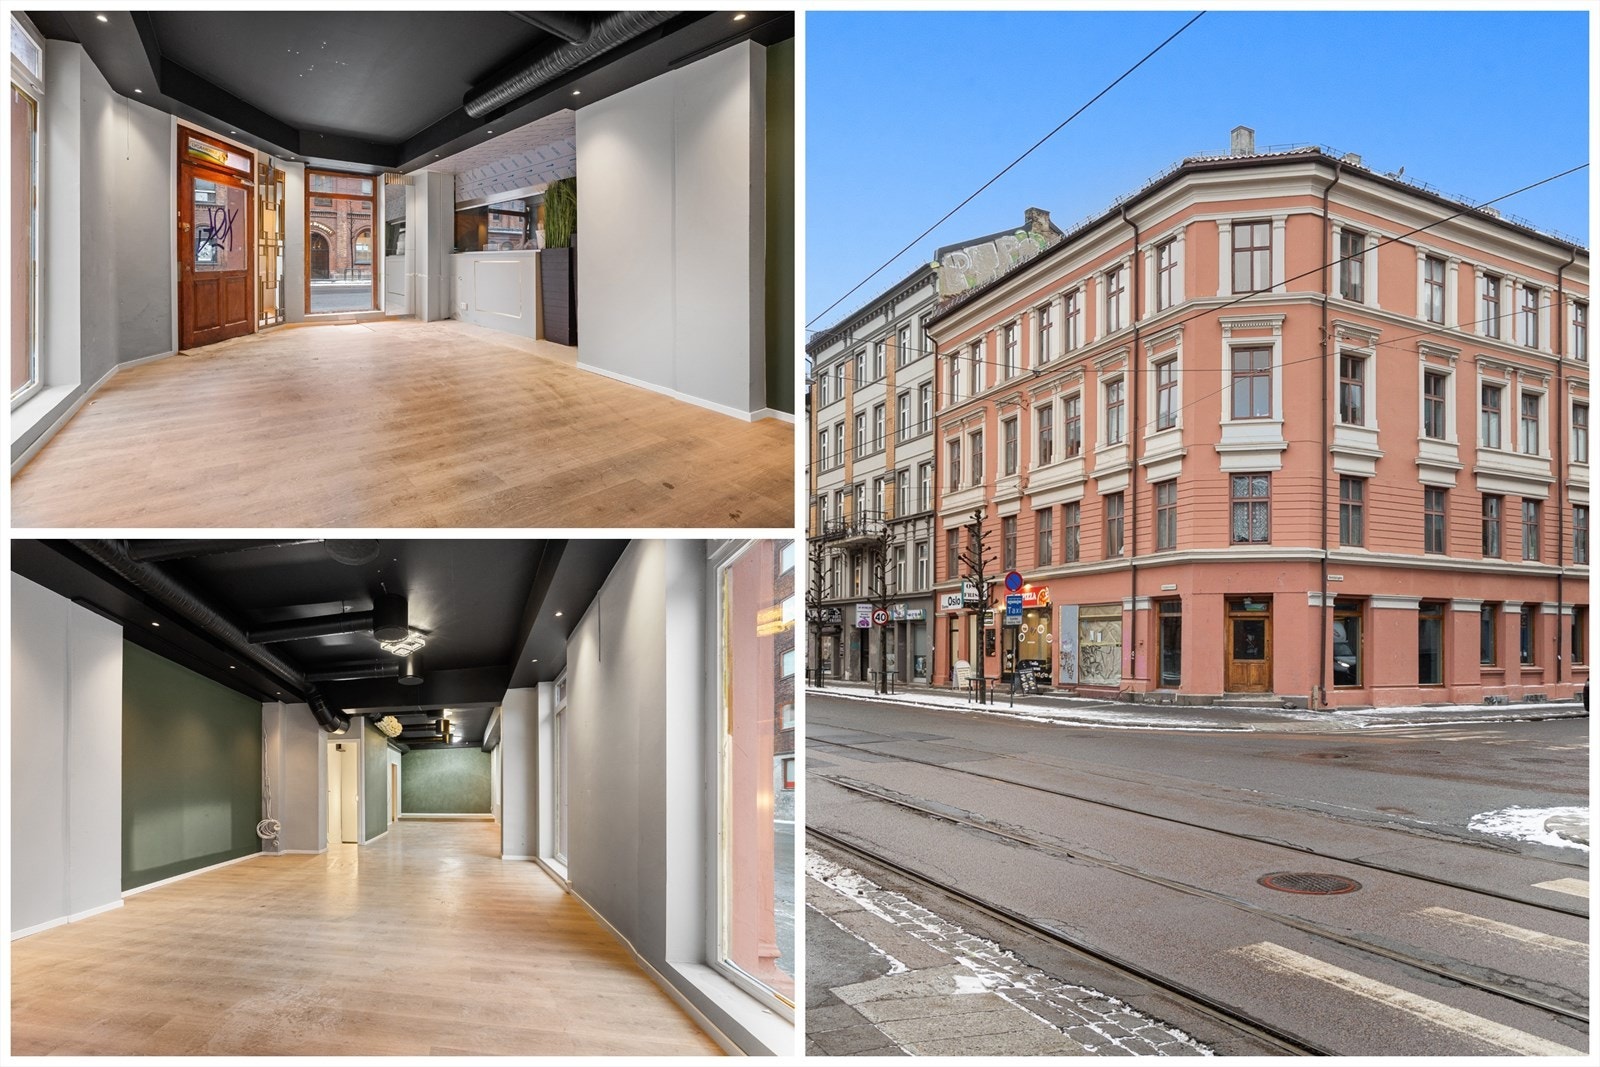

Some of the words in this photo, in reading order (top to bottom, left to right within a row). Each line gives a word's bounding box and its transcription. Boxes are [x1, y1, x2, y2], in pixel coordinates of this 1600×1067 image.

[947, 596, 960, 606] Oslo
[1007, 606, 1022, 614] Taxi
[875, 613, 886, 622] 40
